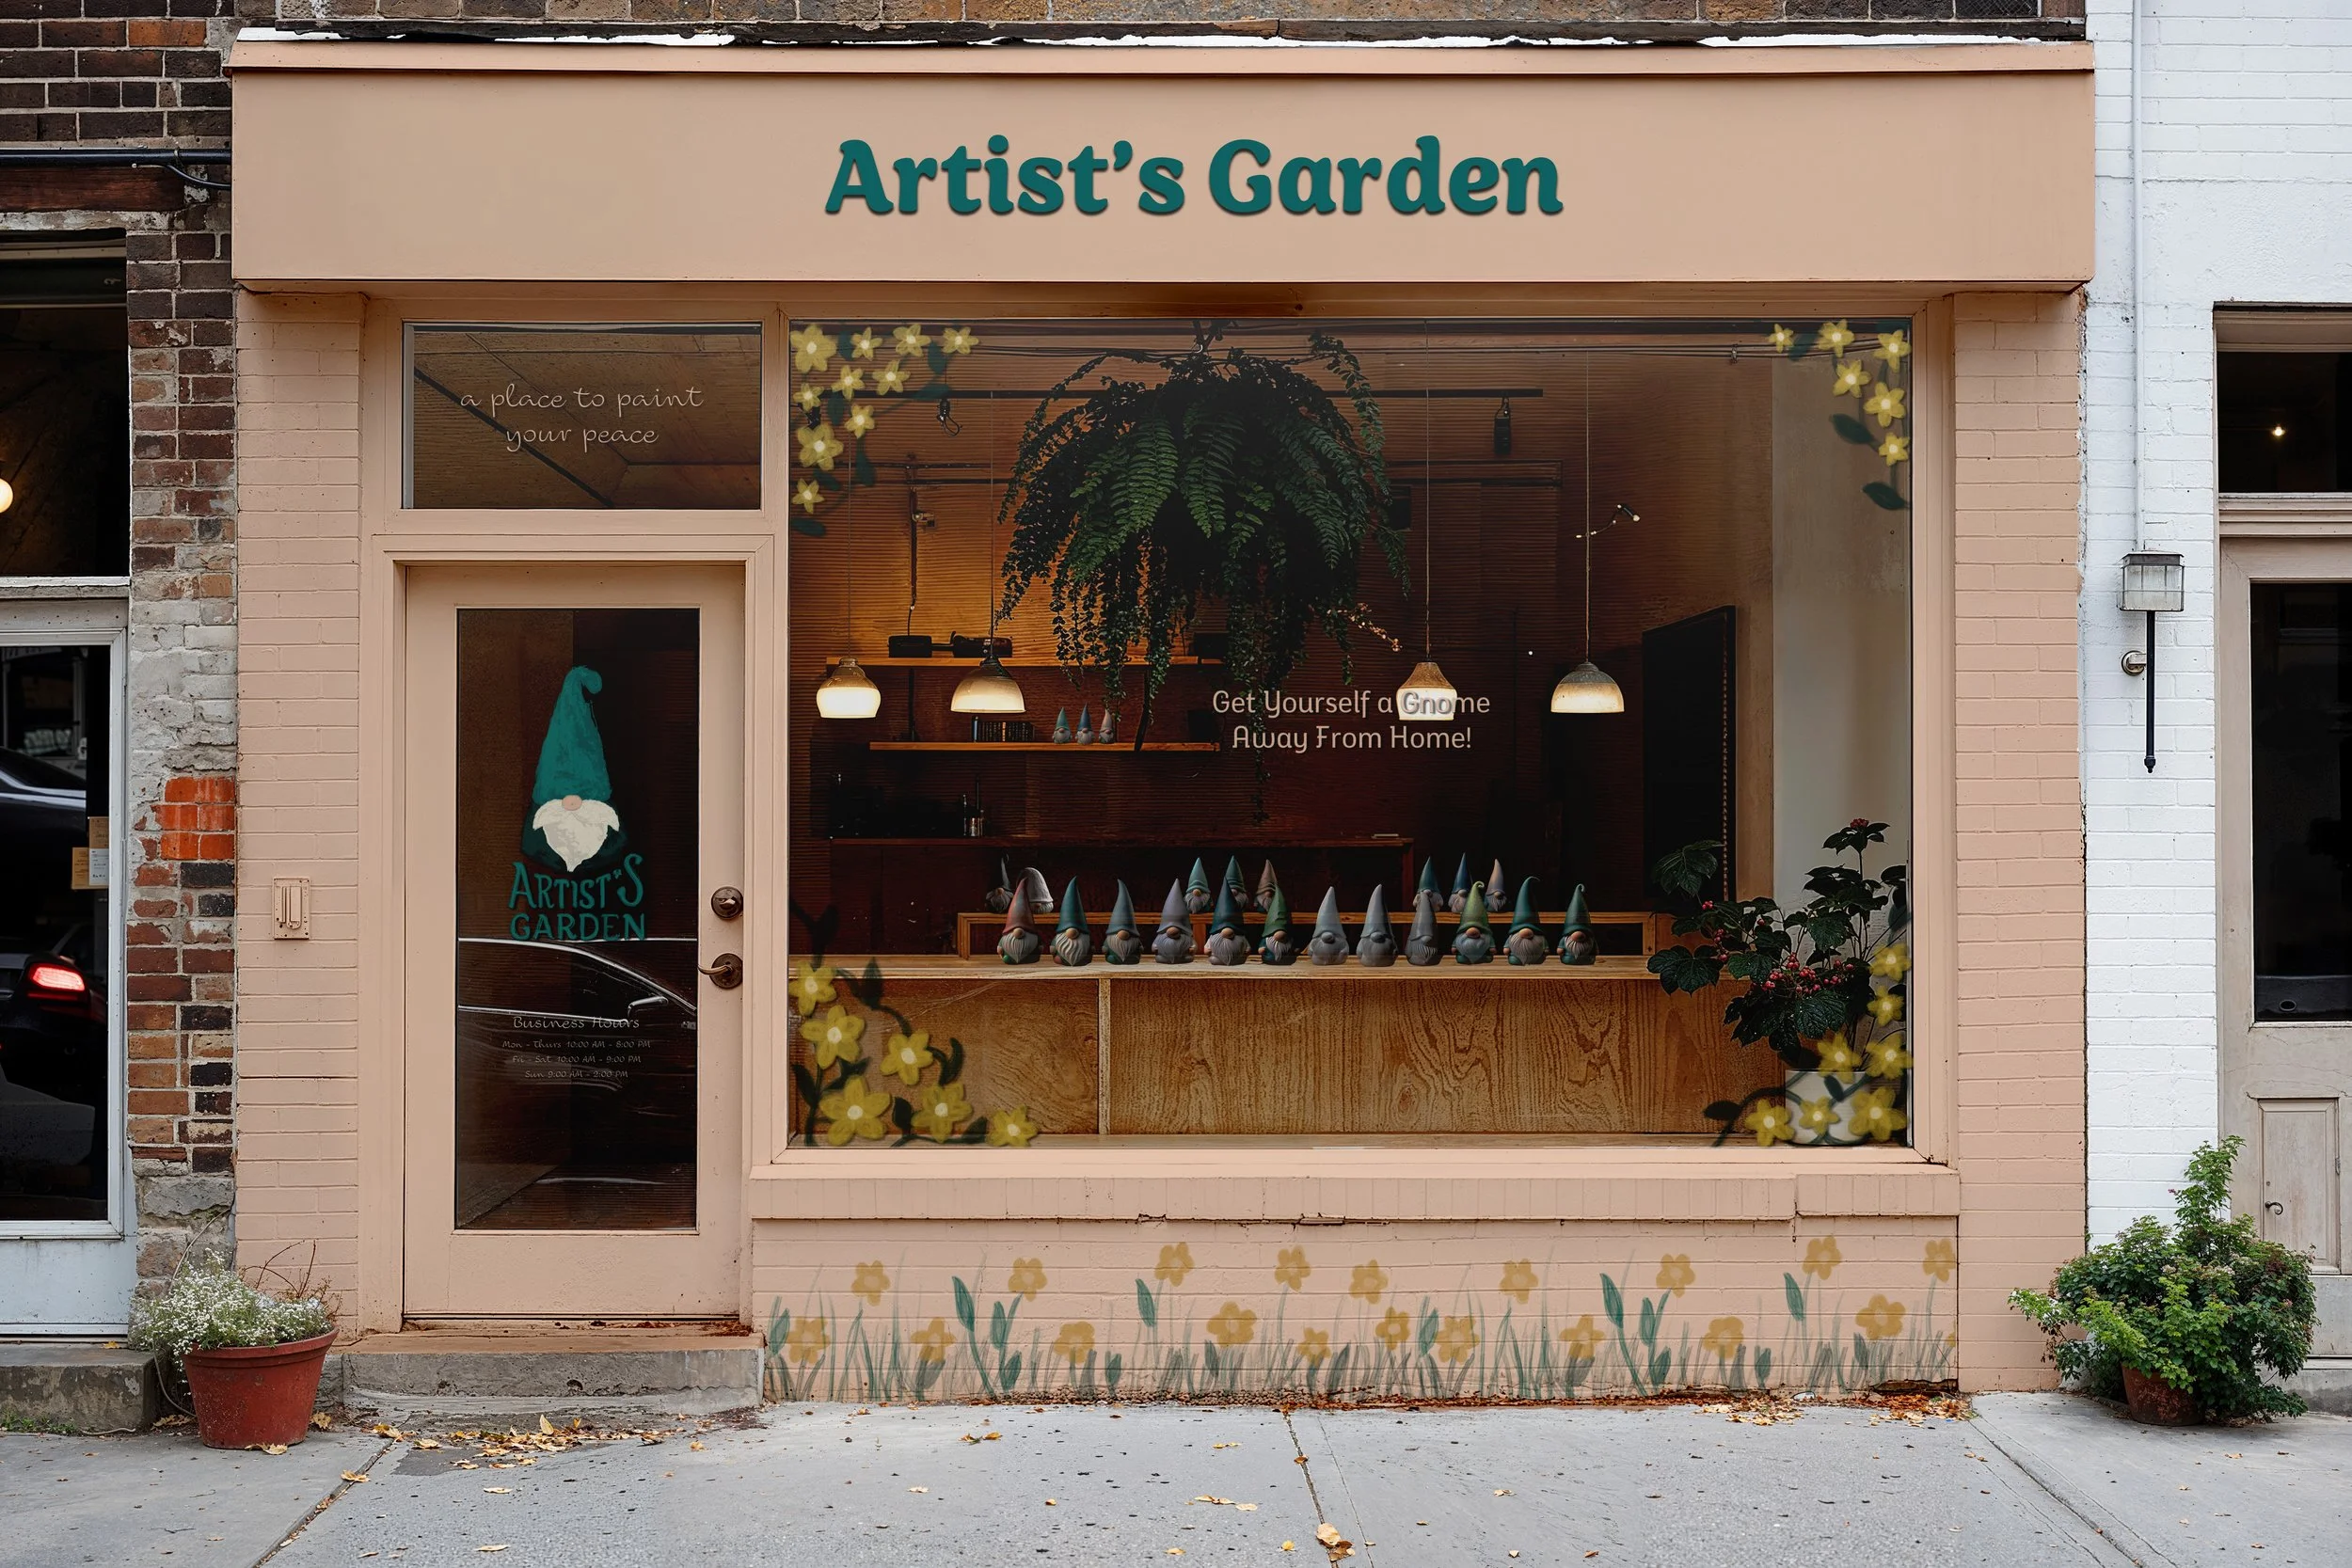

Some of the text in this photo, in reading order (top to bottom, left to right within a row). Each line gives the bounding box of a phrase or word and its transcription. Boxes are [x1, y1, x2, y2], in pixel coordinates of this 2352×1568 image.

[825, 135, 1563, 214] Artist's Garden
[460, 383, 704, 418] a place to paint
[506, 428, 659, 452] your peace
[1212, 689, 1490, 719] Get Yourself a Gnome
[1232, 725, 1471, 753] Away From Home!
[509, 911, 645, 941] GARDEN
[513, 1016, 640, 1029] Business Hours
[501, 1040, 523, 1049] Mon
[532, 1038, 562, 1049] Thurs
[566, 1040, 590, 1049] 10:00
[591, 1040, 606, 1049] AM
[615, 1040, 635, 1049] 8:00
[637, 1040, 651, 1049] PM
[512, 1055, 526, 1064] Fri
[534, 1055, 552, 1064] Sat
[557, 1055, 580, 1064] 10:00
[581, 1055, 596, 1064] AM
[605, 1055, 626, 1065] 9:00
[628, 1055, 642, 1064] PM
[524, 1070, 545, 1079] Sun
[548, 1070, 567, 1079] 9:00
[568, 1070, 583, 1079] AM
[614, 1070, 628, 1079] PM
